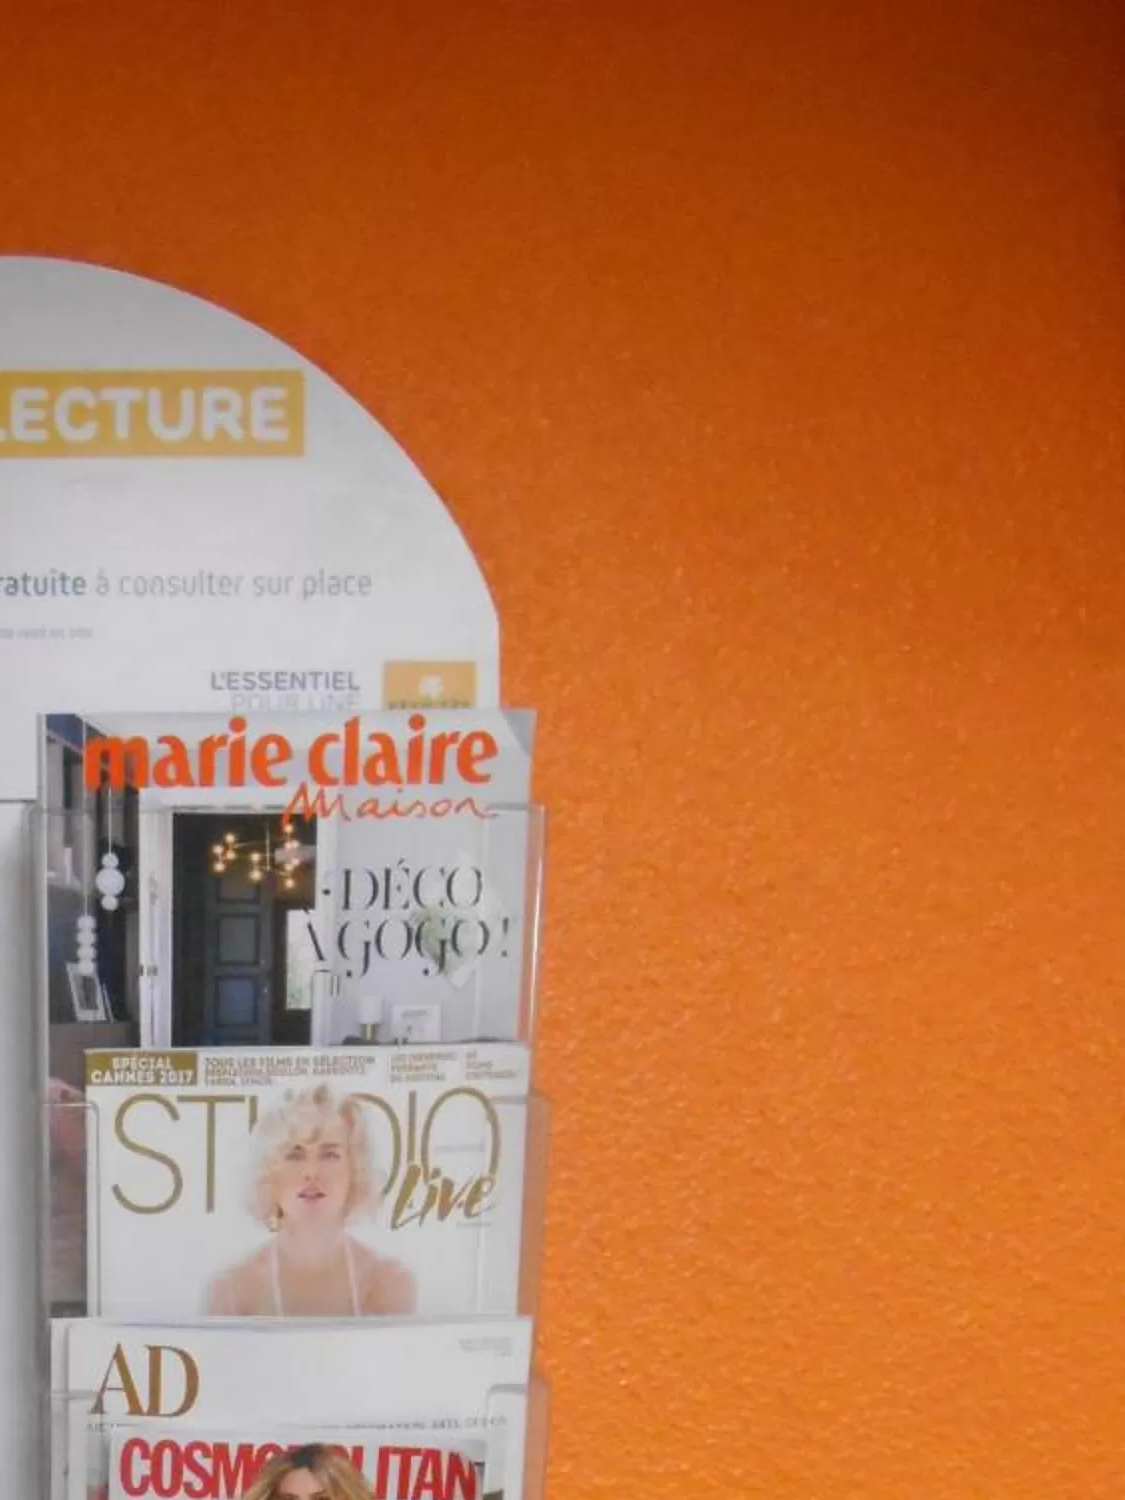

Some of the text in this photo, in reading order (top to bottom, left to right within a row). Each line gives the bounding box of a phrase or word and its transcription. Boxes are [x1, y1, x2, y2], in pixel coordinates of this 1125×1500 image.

[96, 569, 109, 596] à
[119, 569, 243, 597] consulter
[253, 574, 294, 597] sur
[302, 570, 372, 600] place
[211, 671, 361, 692] L'ESSENTIEL
[85, 713, 498, 790] marie claire
[283, 781, 499, 826] Maison
[90, 1070, 155, 1085] CANNES
[112, 1086, 502, 1216] STDIO
[390, 1163, 497, 1231] Live
[87, 1342, 201, 1419] AD
